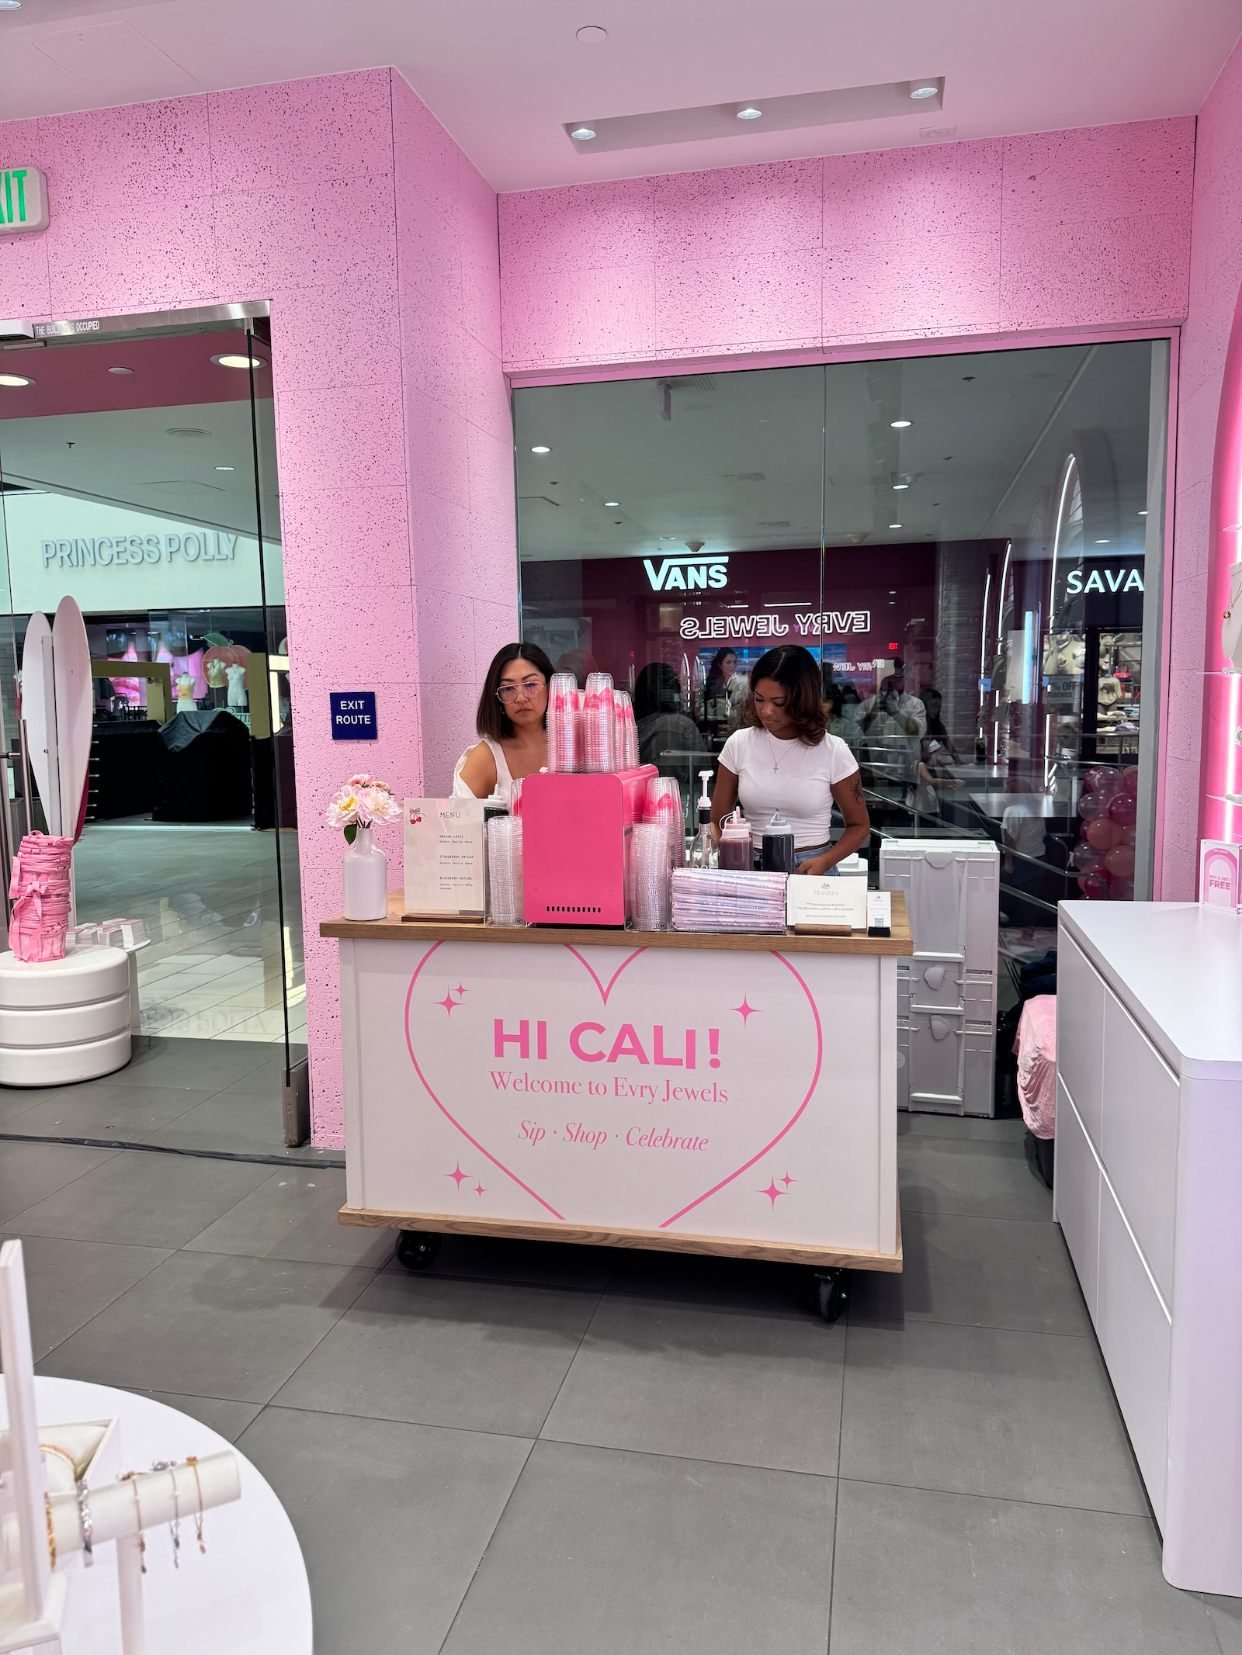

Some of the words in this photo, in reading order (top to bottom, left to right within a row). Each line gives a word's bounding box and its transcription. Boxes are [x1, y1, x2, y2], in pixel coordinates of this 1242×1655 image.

[36, 326, 45, 335] THE
[75, 320, 100, 332] OCCUPIED
[41, 534, 161, 568] PRINCESS
[164, 530, 238, 563] POLLY
[643, 556, 729, 591] VANS
[1066, 568, 1145, 594] SAVA
[340, 700, 365, 710] EXIT
[336, 715, 371, 725] ROUTE
[440, 811, 461, 819] MENU
[1209, 880, 1231, 891] FREE
[494, 1018, 547, 1060] HI
[569, 1021, 721, 1070] CALI!
[489, 1070, 582, 1094] Welcome
[588, 1079, 608, 1096] to
[612, 1076, 658, 1105] Evry
[662, 1079, 729, 1104] Jewels
[518, 1119, 546, 1146] Sip
[562, 1122, 608, 1150] Shop
[625, 1126, 709, 1151] Celebrate
